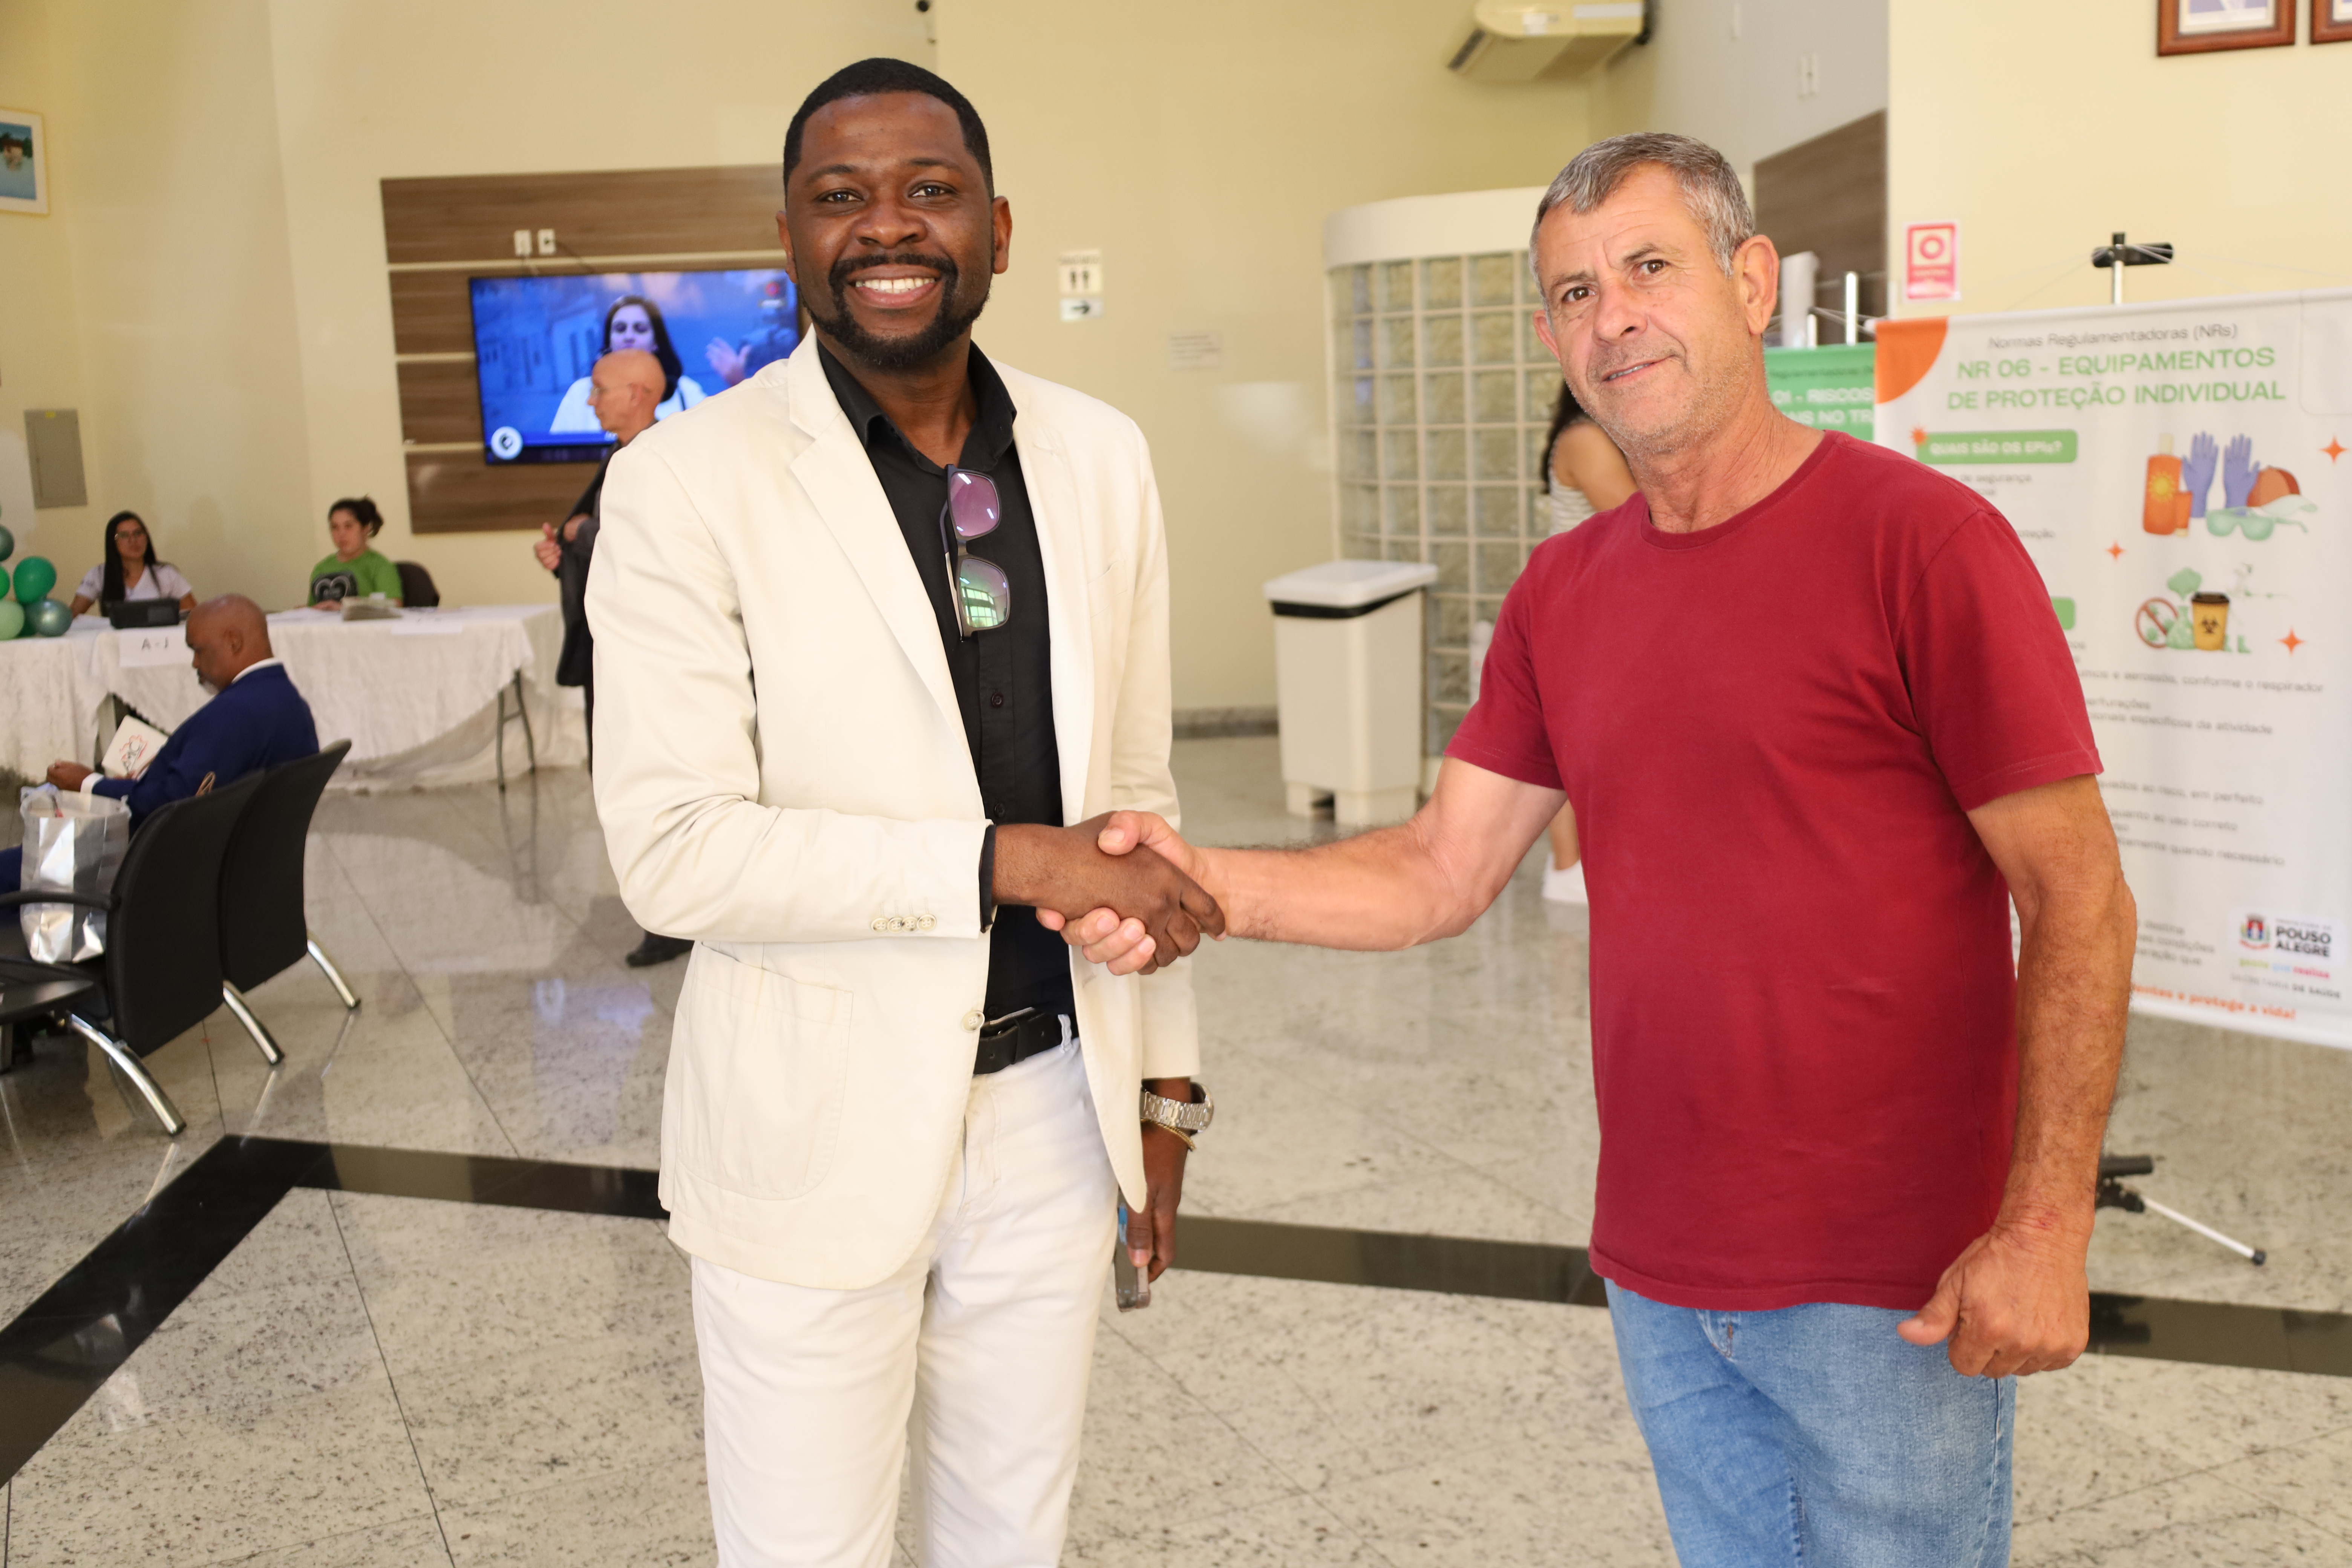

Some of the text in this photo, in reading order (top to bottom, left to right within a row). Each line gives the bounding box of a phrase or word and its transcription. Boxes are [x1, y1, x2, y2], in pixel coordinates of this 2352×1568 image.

[1989, 323, 2238, 348] Normas Regulamentadoras (NRs)
[1958, 361, 1991, 378] NR
[1998, 358, 2031, 377] 06
[2059, 346, 2275, 375] EQUIPAMENTOS
[1948, 380, 2286, 411] DE PROTEÇÃO INDIVIDUAL
[1819, 409, 1845, 425] NO
[1930, 442, 1969, 456] QUAIS
[1972, 438, 1999, 454] SÃO
[2001, 441, 2022, 454] OS
[2183, 675, 2241, 688] conforme
[2257, 680, 2323, 694] respirador
[2216, 720, 2272, 734] atividade
[2213, 792, 2263, 805] perfeito
[2192, 818, 2238, 831] correto
[2217, 849, 2286, 867] necessário
[2276, 925, 2332, 945] POUSO
[2275, 940, 2330, 958] ALEGRE
[2189, 993, 2245, 1013] protege
[2262, 1004, 2297, 1019] vida!
